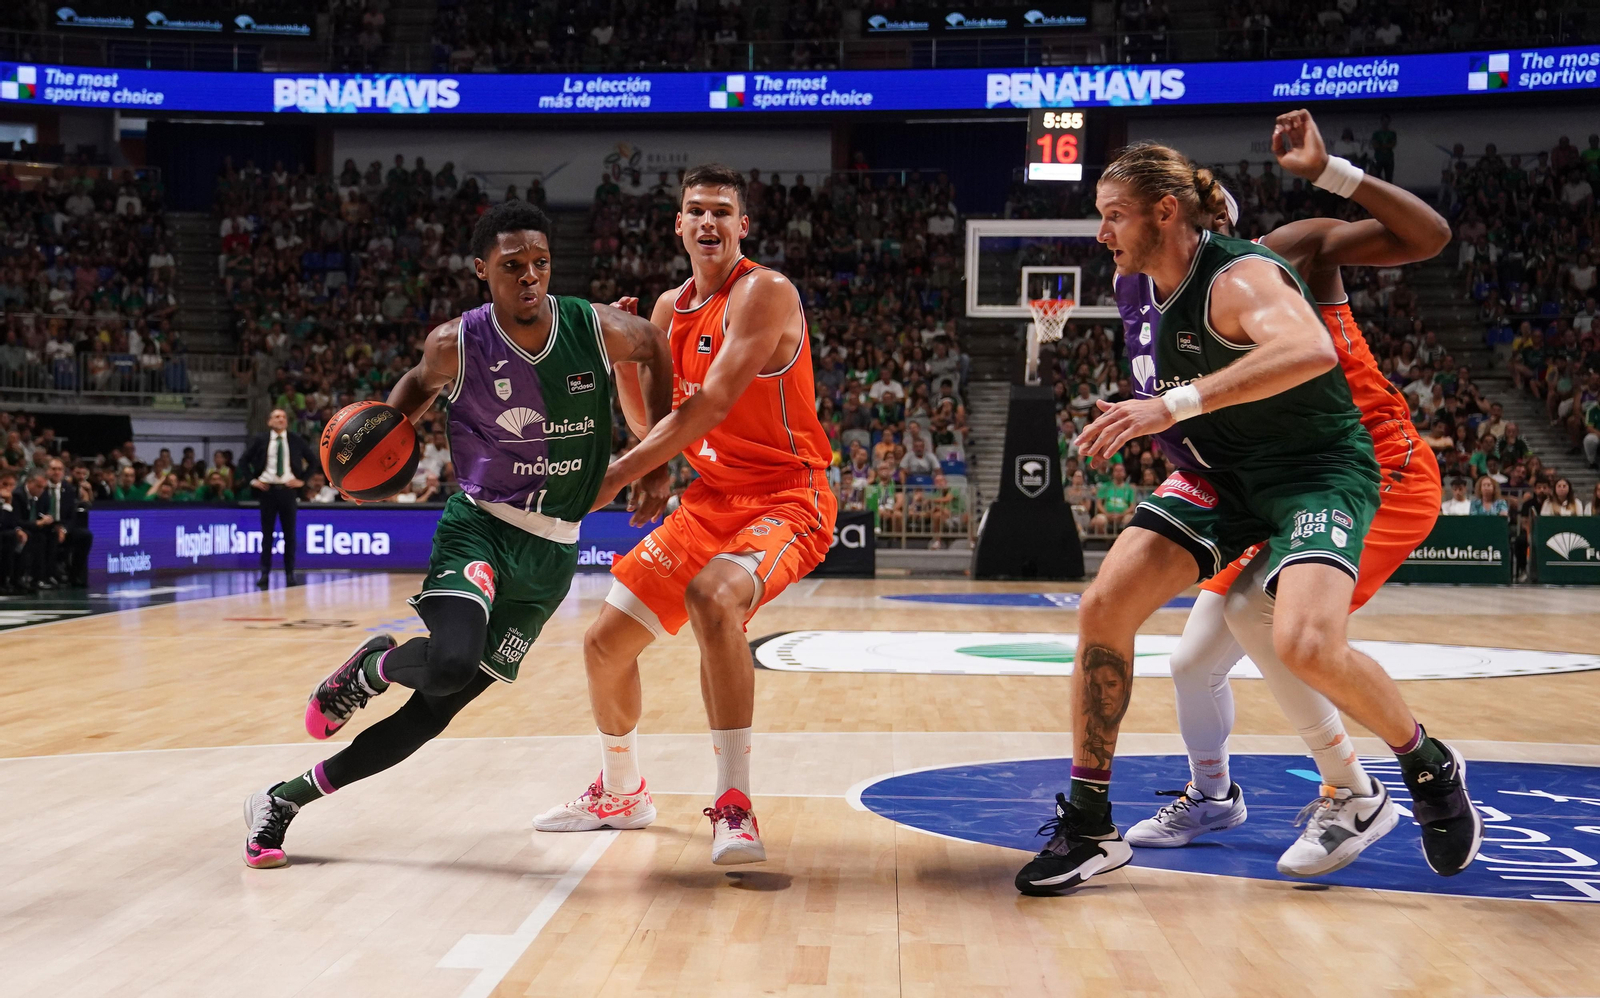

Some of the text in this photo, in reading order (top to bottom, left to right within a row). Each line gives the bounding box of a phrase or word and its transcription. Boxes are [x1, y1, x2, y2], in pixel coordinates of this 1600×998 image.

[1300, 59, 1400, 80] La elección
[1520, 51, 1600, 70] The mos
[45, 67, 119, 88] The most
[563, 75, 652, 93] La elección
[753, 75, 828, 91] The most
[986, 69, 1186, 103] BENAHAVIS
[1273, 75, 1400, 98] más deportiva
[1518, 68, 1597, 89] sportive
[44, 86, 165, 105] sportive choice
[273, 78, 461, 109] BENAHAVIS
[538, 90, 651, 111] más deportiva
[752, 89, 873, 109] sportive choice
[1042, 111, 1084, 129] 5:55
[1036, 133, 1078, 164] 16
[542, 416, 595, 434] Unicaja
[525, 489, 548, 513] 11
[175, 523, 214, 564] Hospital
[305, 523, 391, 555] Elena
[644, 533, 673, 570] PULEVA
[1407, 545, 1502, 562] aciónUnicaja
[120, 551, 152, 575] hospitales
[577, 545, 616, 565] ales
